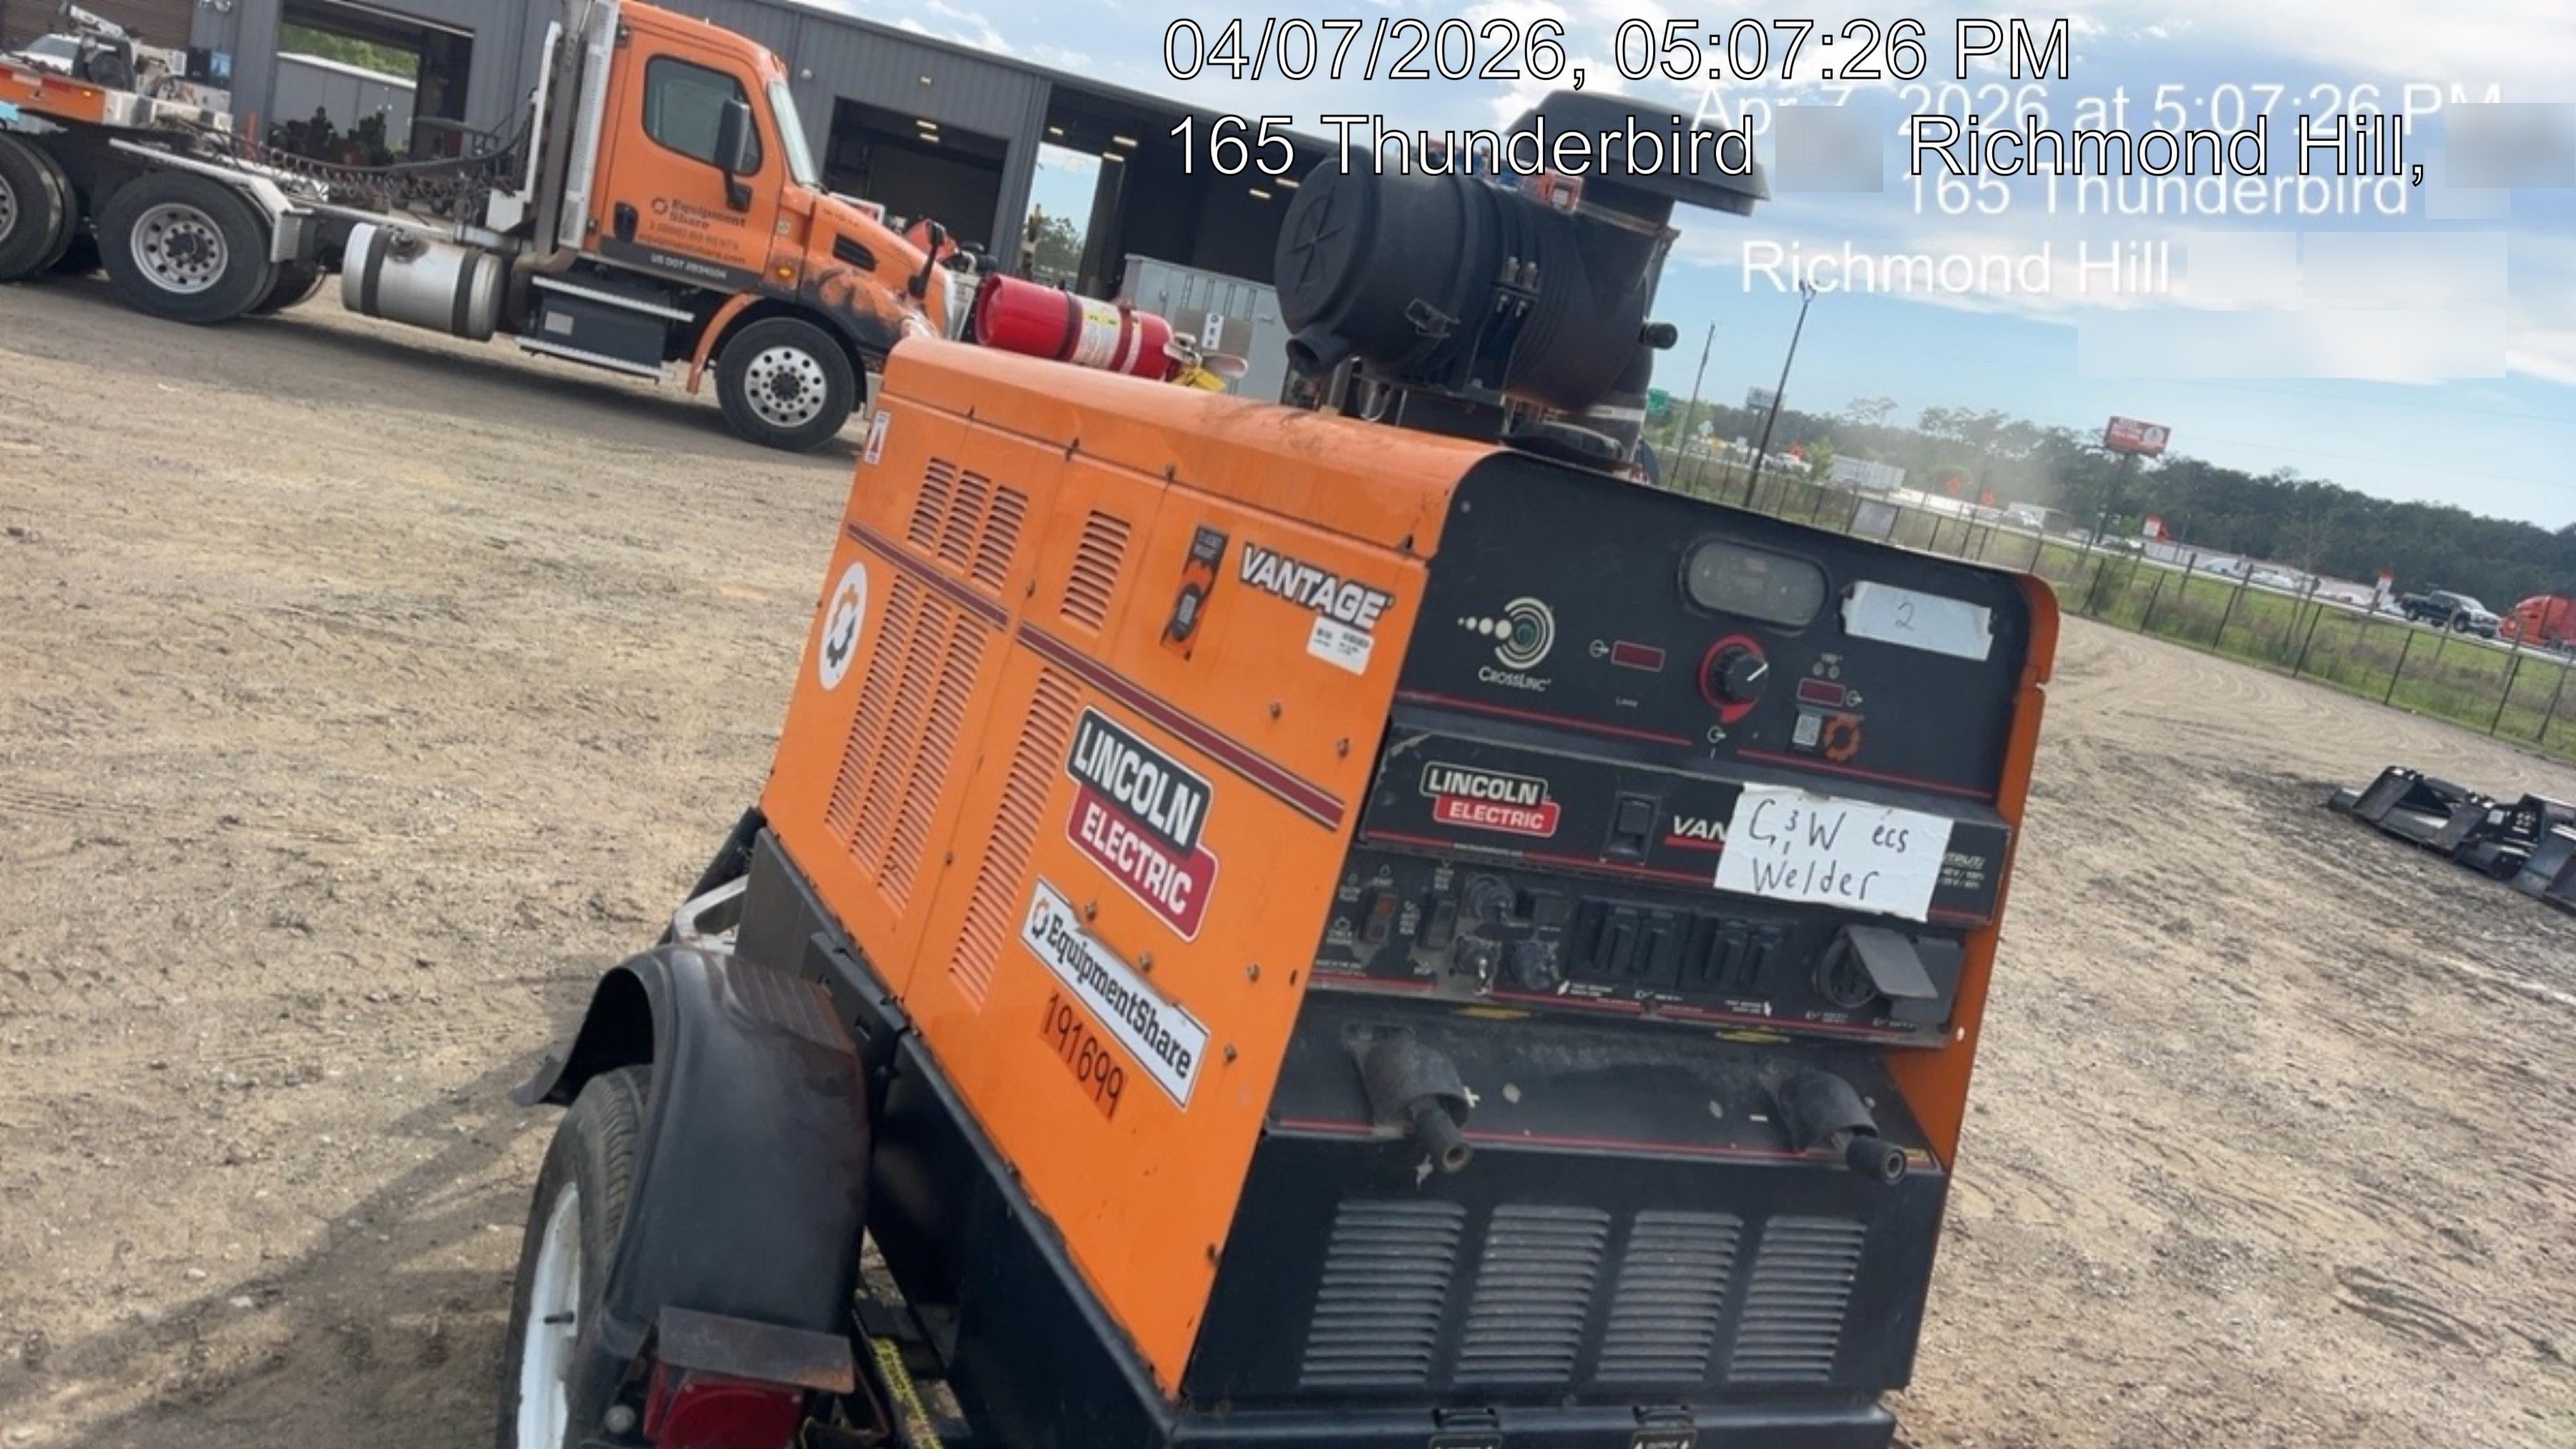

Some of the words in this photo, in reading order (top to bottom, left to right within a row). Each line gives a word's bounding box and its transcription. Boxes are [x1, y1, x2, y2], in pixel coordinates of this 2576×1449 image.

[1239, 542, 1393, 633] VANTAGE
[1895, 601, 1915, 631] 2
[1073, 721, 1201, 847] LINCOLN
[1428, 768, 1538, 806] LINCOLN
[1448, 801, 1545, 830] ELECTRIC
[1080, 801, 1193, 916] ELECTRIC
[1752, 858, 1880, 900] Welder
[1046, 914, 1193, 1079] EquipmentShare
[1044, 992, 1124, 1120] 191699
